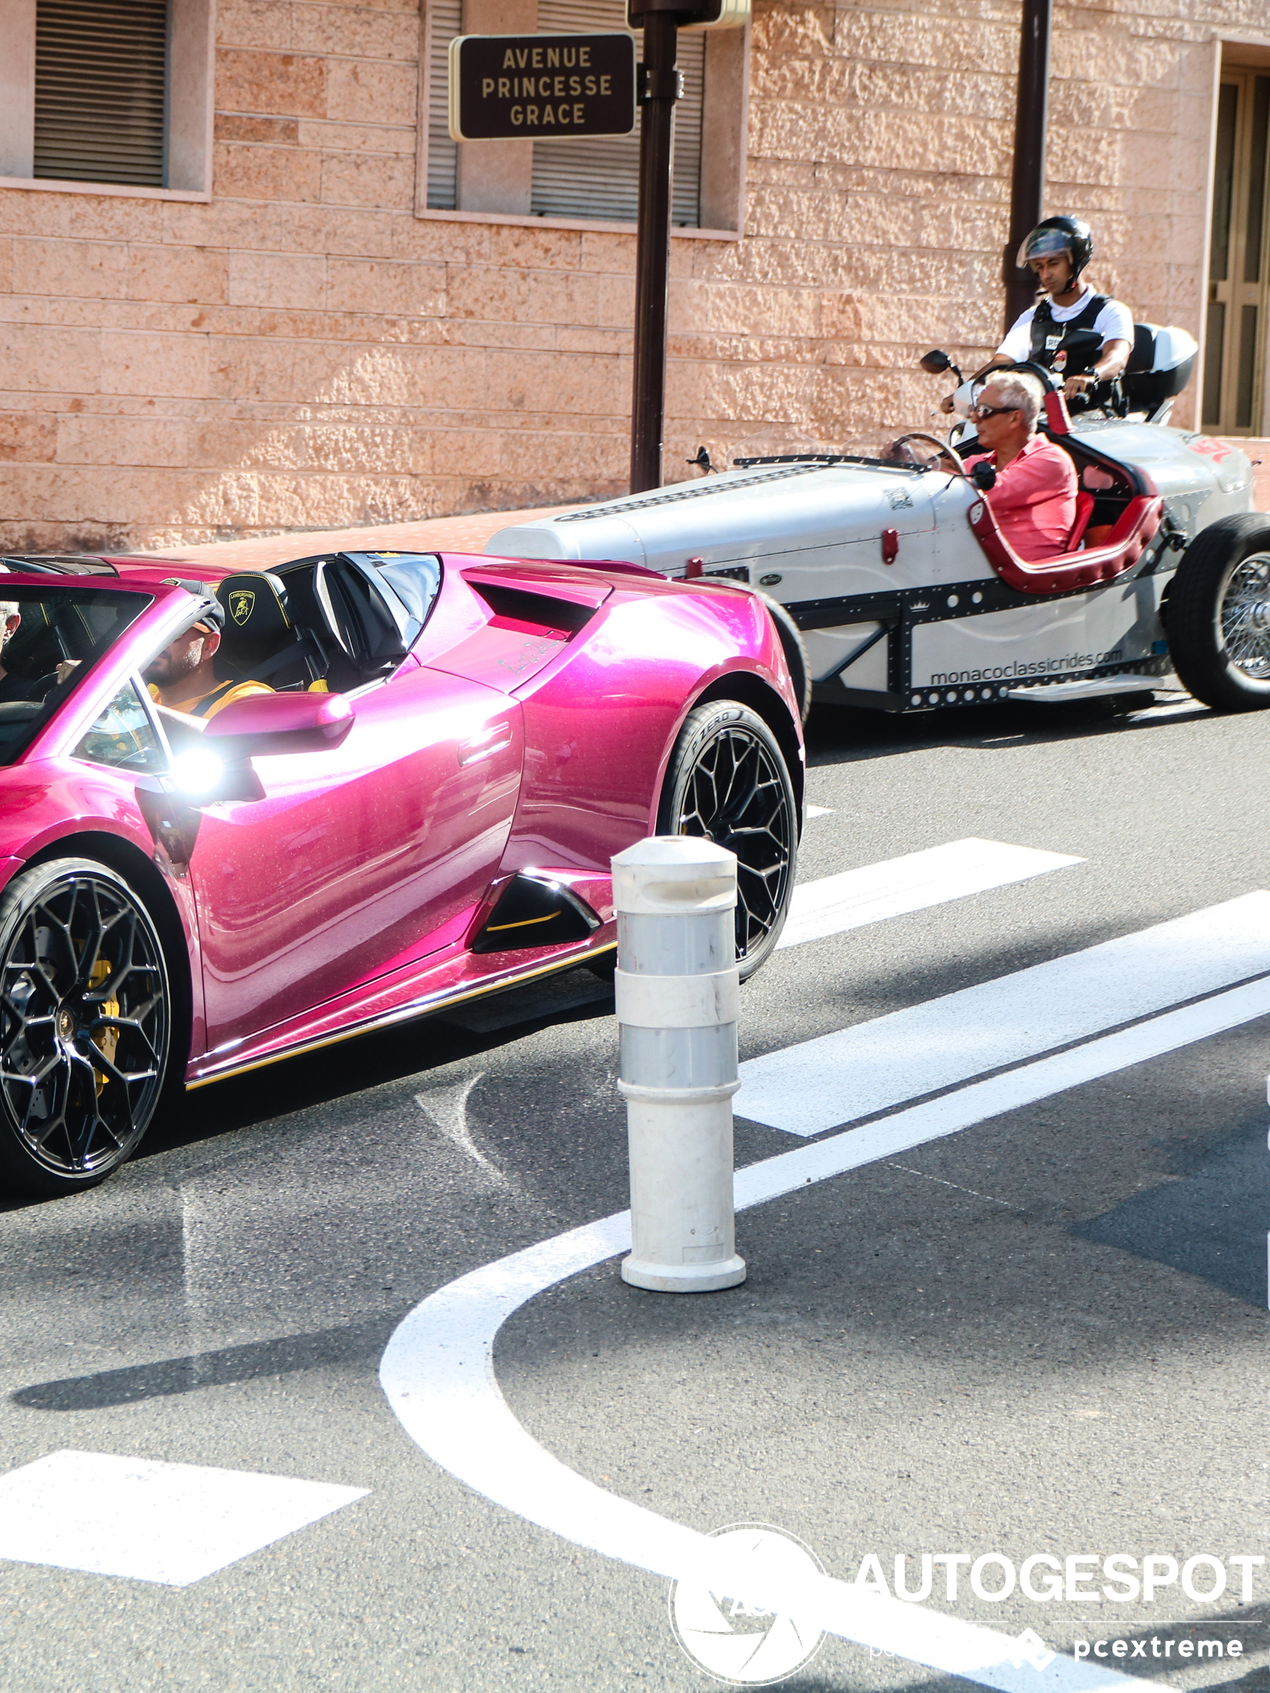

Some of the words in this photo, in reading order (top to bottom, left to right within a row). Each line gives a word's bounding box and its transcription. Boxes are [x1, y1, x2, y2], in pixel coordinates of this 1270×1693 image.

[503, 47, 591, 68] AVENUE
[482, 75, 612, 98] PRINCESSE
[510, 103, 585, 125] GRACE
[931, 650, 1122, 685] monacoclassicrides.com
